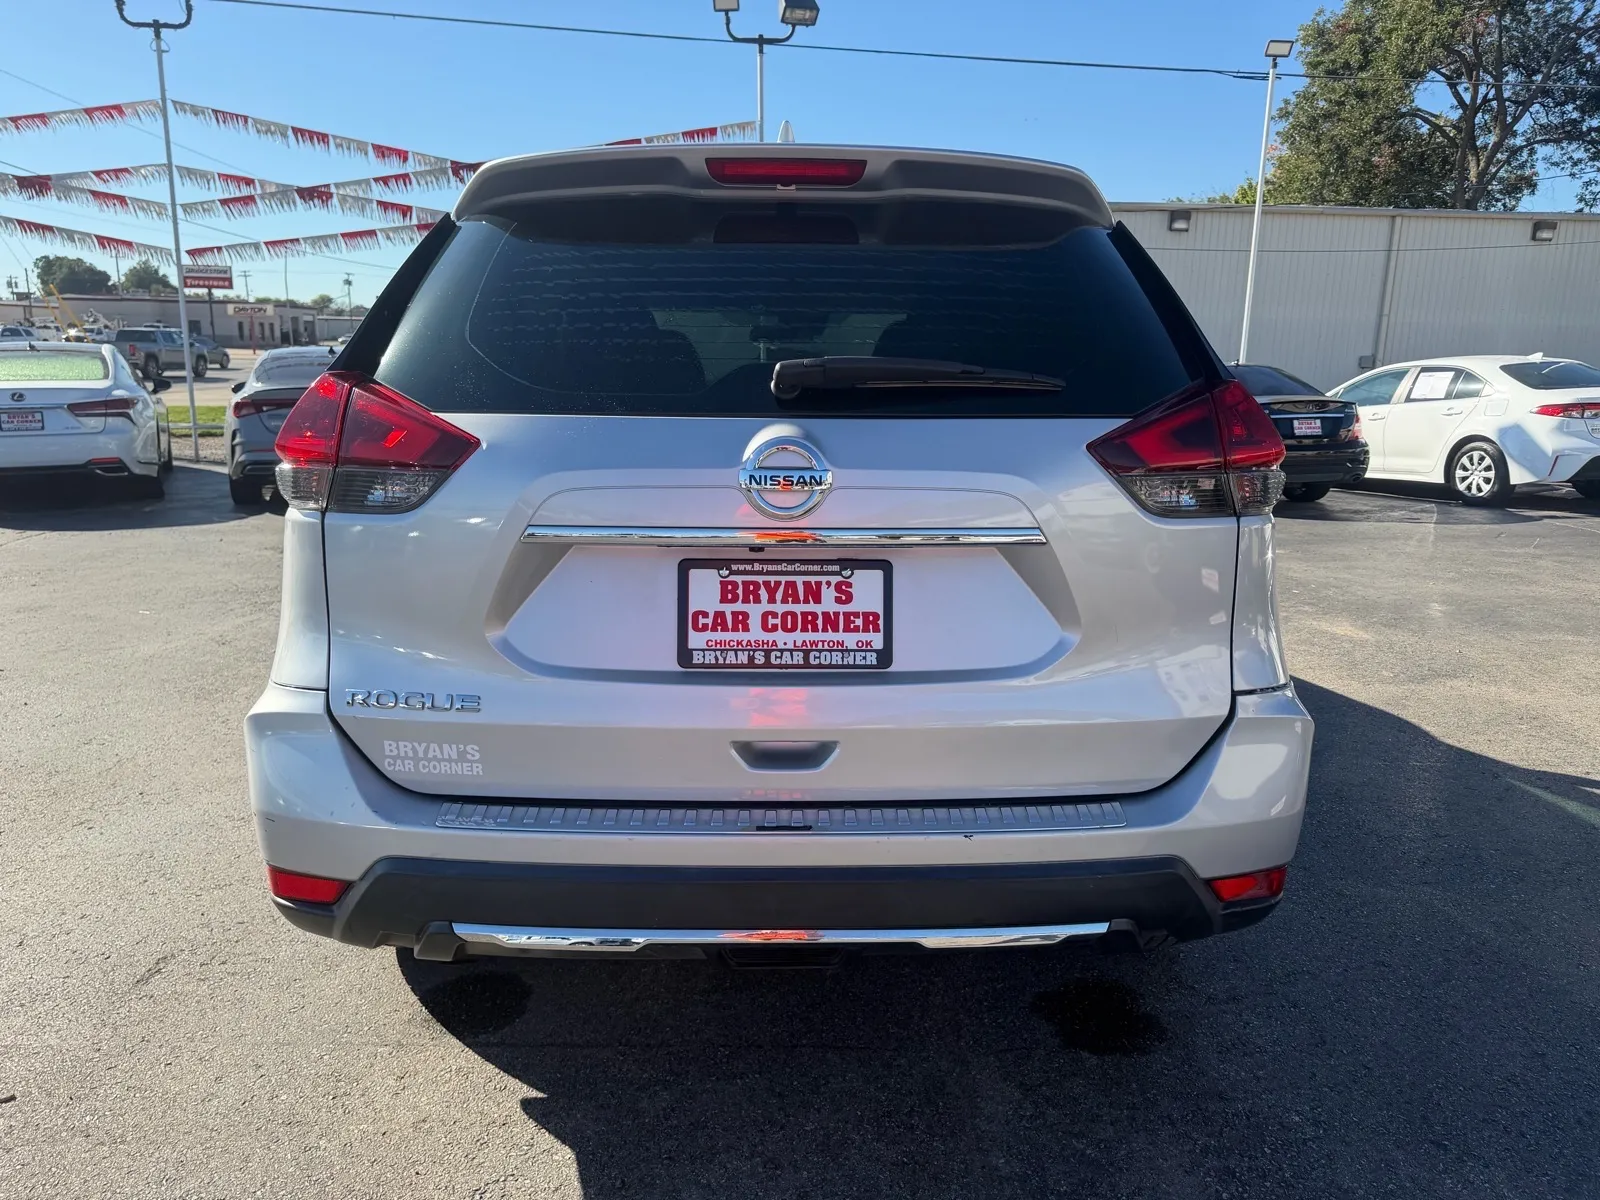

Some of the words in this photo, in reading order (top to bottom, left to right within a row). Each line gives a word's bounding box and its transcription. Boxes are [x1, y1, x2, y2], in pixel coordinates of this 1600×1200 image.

[748, 474, 823, 487] NISSAN
[731, 563, 840, 573] www.BryansCarCorner.com
[719, 580, 854, 605] BRYAN'S
[691, 610, 751, 633] CAR
[760, 610, 881, 633] CORNER
[705, 639, 779, 649] CHICKASHA
[793, 639, 849, 650] LAWTON,
[855, 639, 874, 649] OK
[692, 650, 766, 665] BRYAN'S
[770, 650, 804, 665] CAR
[809, 650, 878, 665] CORNER
[345, 688, 482, 713] ROGUE
[383, 740, 481, 761] BRYAN'S
[384, 758, 415, 772] CAR
[418, 760, 484, 775] CORNER
